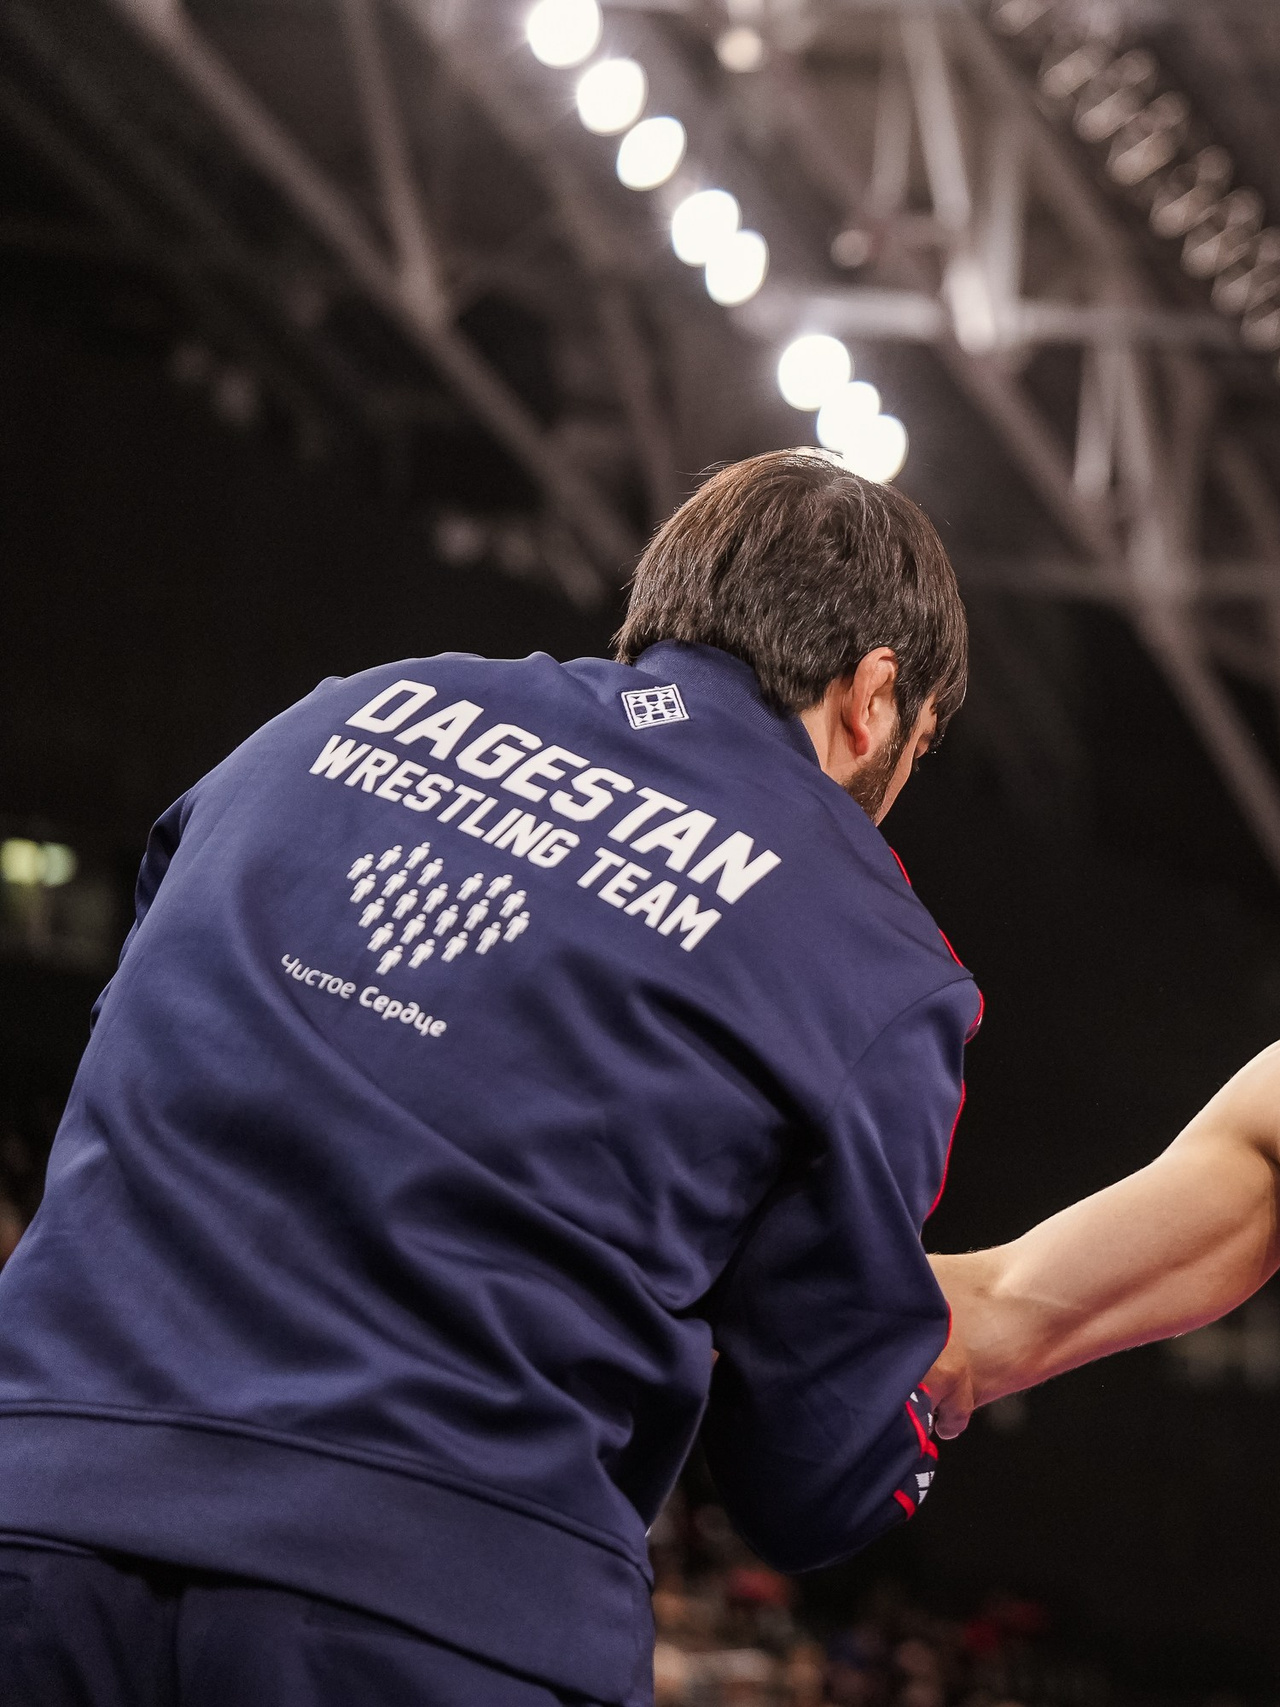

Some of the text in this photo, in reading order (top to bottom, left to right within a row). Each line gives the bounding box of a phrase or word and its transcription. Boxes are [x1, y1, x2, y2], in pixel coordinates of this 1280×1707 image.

[308, 734, 722, 952] WRESTLING TEAM
[344, 679, 782, 905] DAGESTAN
[280, 952, 448, 1038] Чистое Сердце
